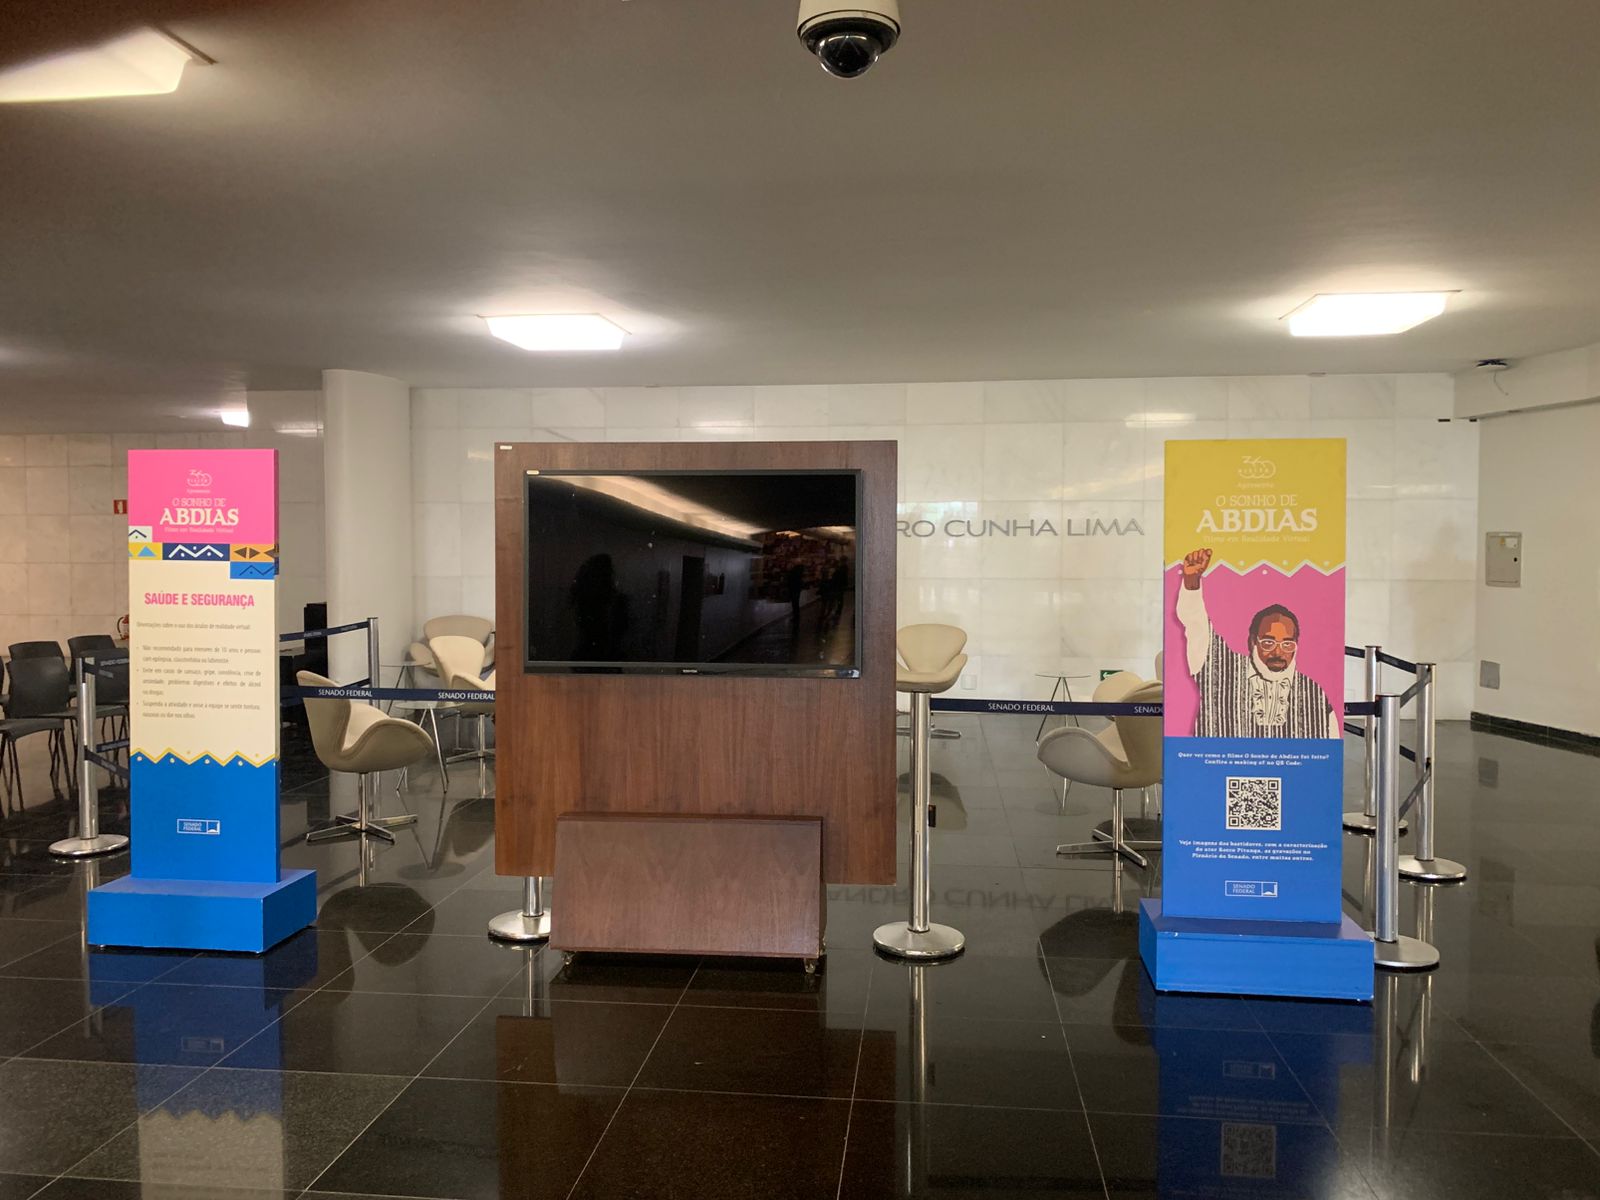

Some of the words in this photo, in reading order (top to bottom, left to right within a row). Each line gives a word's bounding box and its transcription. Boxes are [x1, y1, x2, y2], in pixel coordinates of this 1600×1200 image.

[172, 498, 181, 507] O
[181, 498, 212, 507] SONHO
[214, 498, 226, 507] DE
[1215, 495, 1226, 507] O
[1229, 495, 1277, 507] SONHO
[1280, 494, 1298, 506] DE
[159, 507, 239, 526] ABDIAS
[1196, 508, 1318, 533] ABDIAS
[944, 519, 1058, 537] CUNHA
[1067, 518, 1145, 537] LIMA
[144, 590, 179, 605] SAÚDE
[181, 593, 188, 606] E
[191, 593, 255, 610] SEGURANÇA
[318, 688, 345, 697] SENADO
[346, 689, 373, 698] FEDERAL
[438, 691, 466, 700] SENADO
[467, 692, 495, 700] FEDERAL
[988, 702, 1020, 711] SENADO
[1022, 703, 1055, 712] FEDERAL
